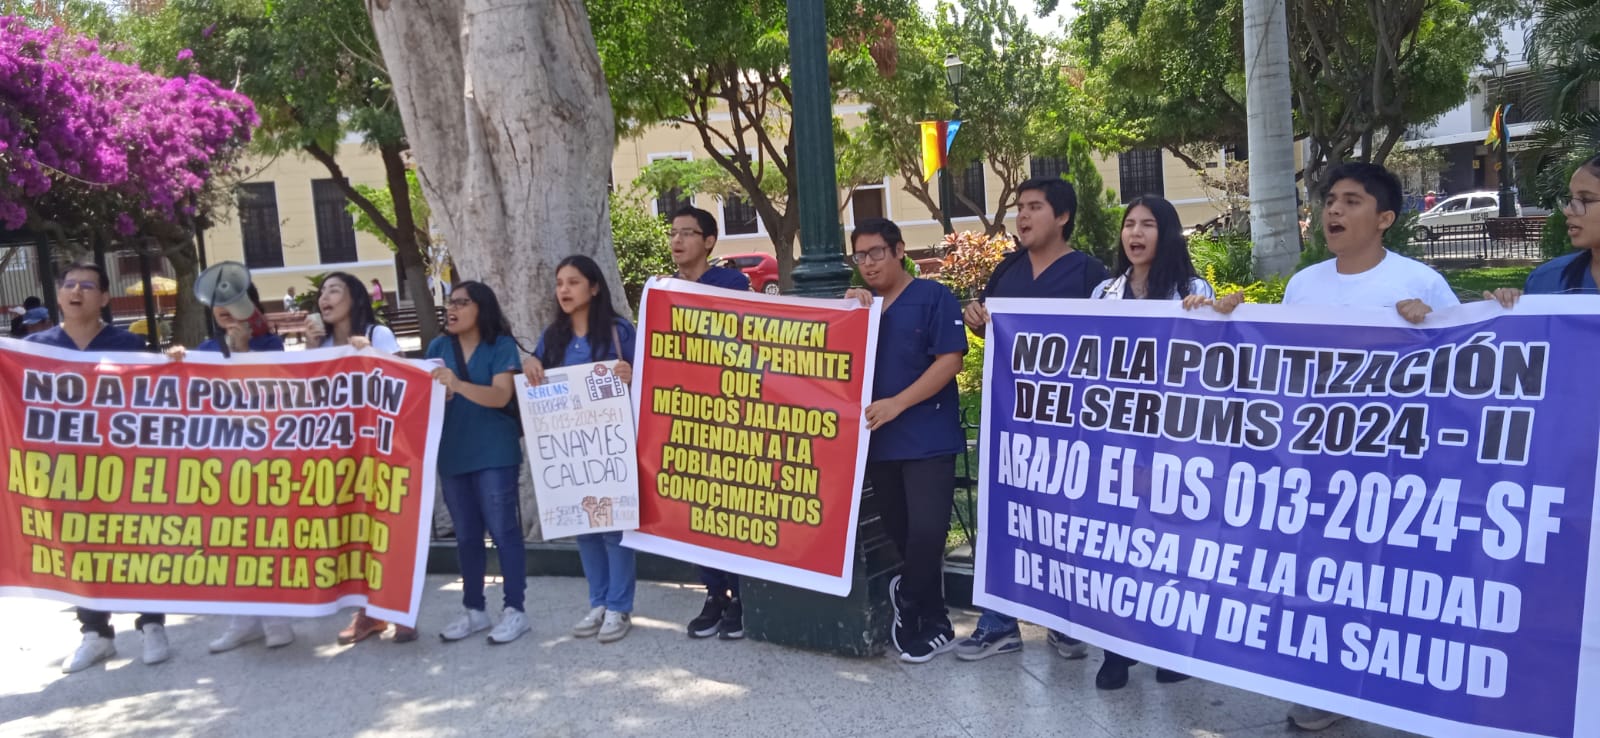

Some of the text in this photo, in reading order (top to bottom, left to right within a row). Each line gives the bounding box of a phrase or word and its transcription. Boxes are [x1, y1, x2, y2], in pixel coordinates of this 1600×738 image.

[672, 307, 827, 348] NUEVO EXAMEN
[651, 333, 850, 380] DEL MINSA PERMITE
[1012, 332, 1549, 400] NO A LA POLITIZACIÓN
[23, 369, 406, 416] NO A LA POLITIZACIÓN
[527, 383, 569, 399] SERUMS
[721, 370, 761, 399] QUE
[23, 408, 103, 444] DEL
[108, 412, 269, 450] SERUMS
[272, 413, 355, 450] 2024
[653, 387, 837, 438] MÉDICOS JALADOS
[1012, 380, 1074, 426] DEL
[1080, 385, 1282, 450] SERUMS
[1289, 403, 1429, 458] 2024
[1438, 428, 1468, 446] -
[670, 419, 812, 465] ATIENDAN A LA
[8, 448, 124, 502] ABAJO
[132, 456, 170, 504] EL
[175, 457, 222, 506] DS
[543, 457, 628, 489] CALIDAD
[662, 446, 819, 495] POBLACIÓN, SIN
[657, 472, 821, 526] CONOCIMIENTOS
[998, 431, 1566, 565] ABAJO EL DS 013-2024-SF
[20, 505, 53, 541] EN
[60, 511, 201, 547] DEFENSA
[209, 515, 249, 548] DE
[254, 516, 289, 549] LA
[691, 502, 777, 547] BÁSICOS
[31, 543, 66, 579] DE
[70, 549, 232, 587] ATENCIÓN
[234, 554, 274, 588] DE
[279, 556, 310, 590] LA
[1008, 500, 1522, 634] EN DEFENSA DE LA CALIDAD
[1014, 548, 1510, 699] DE ATENCIÓN DE LA SALUD
